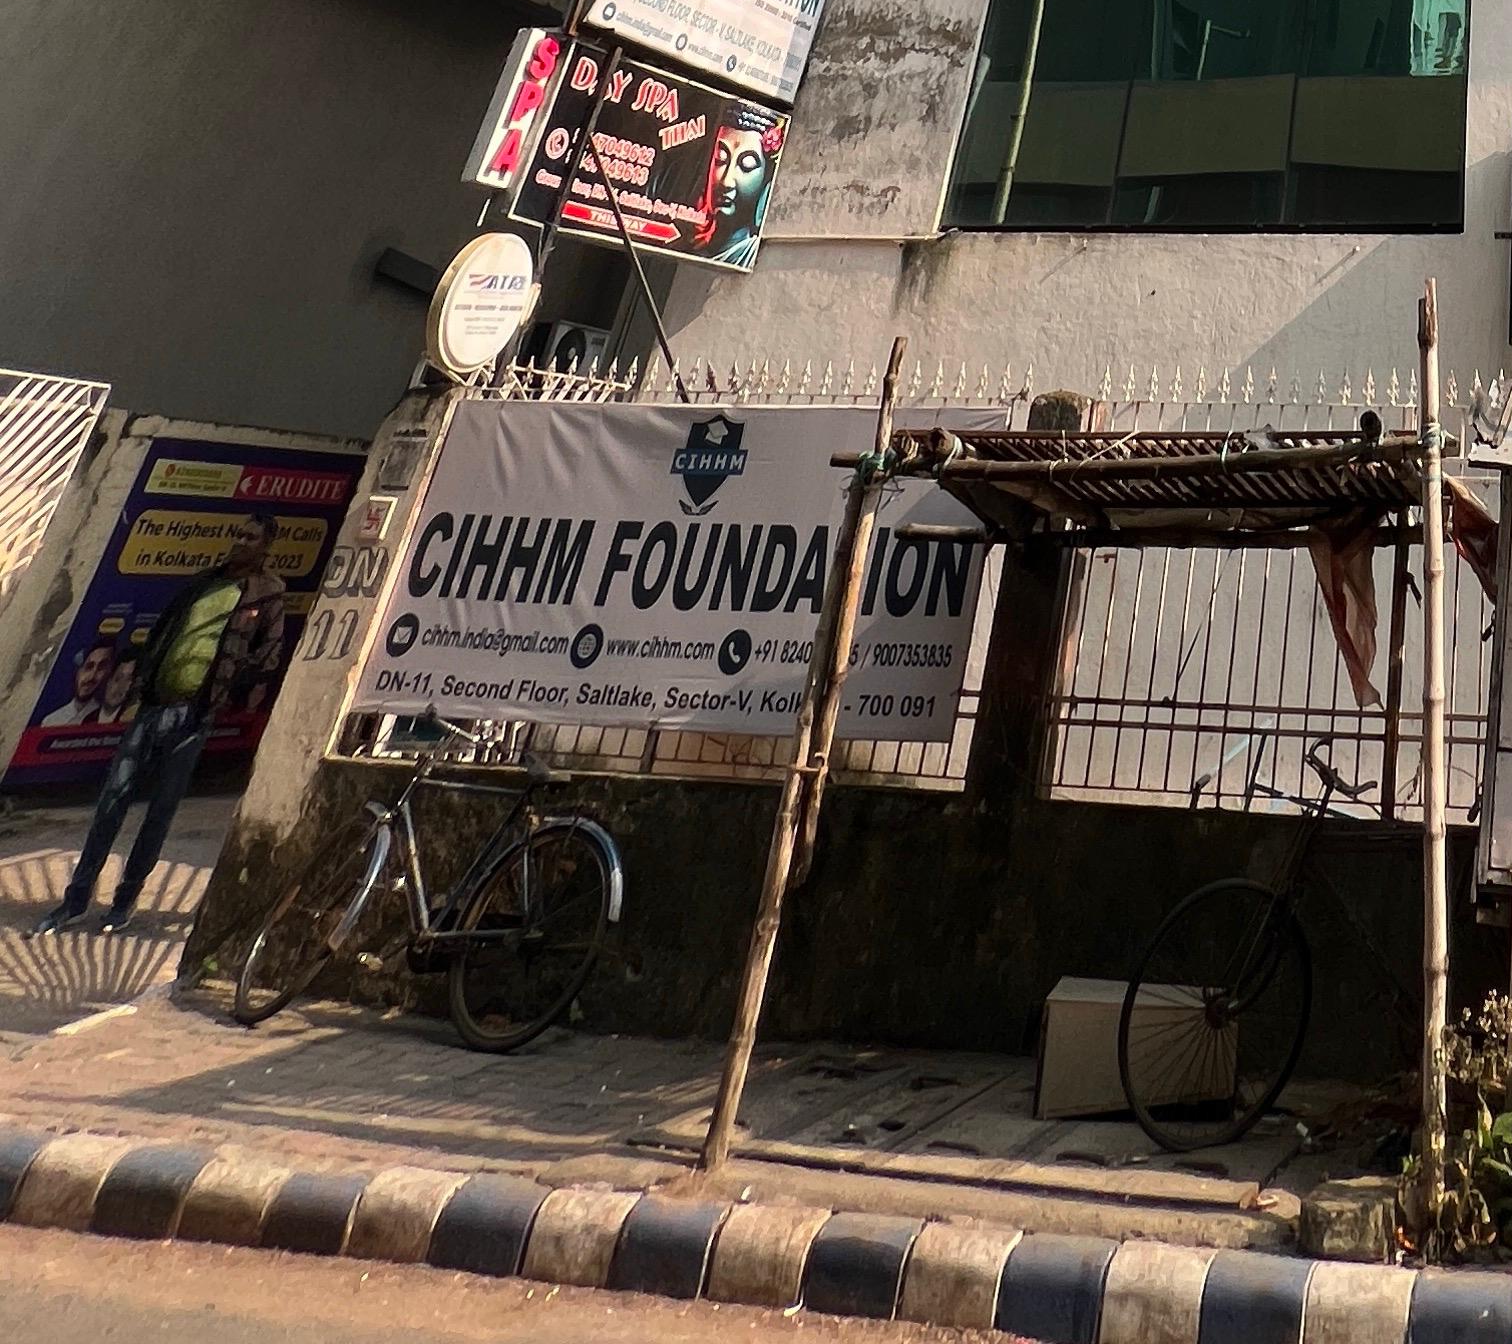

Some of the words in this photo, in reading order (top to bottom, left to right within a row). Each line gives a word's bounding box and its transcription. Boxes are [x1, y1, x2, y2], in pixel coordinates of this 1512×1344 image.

[490, 37, 560, 174] SPA
[570, 55, 633, 104] DY
[631, 77, 680, 124] SPA
[674, 452, 745, 472] CIHHM
[255, 474, 348, 500] ERUDITE
[136, 518, 164, 537] The
[166, 521, 223, 542] Highest
[135, 549, 151, 567] in
[155, 550, 212, 569] Kolkata
[408, 511, 596, 606] CIHHM
[593, 519, 974, 618] FOUNDAION
[302, 609, 359, 660] 11
[605, 635, 715, 661] www.cihhm.com
[754, 639, 779, 663] +91
[375, 669, 435, 698] DN-11,
[440, 674, 514, 701] Second
[517, 679, 569, 706] Floor,
[575, 681, 657, 712] Saltlake,
[663, 686, 753, 716] Sector-V,
[858, 694, 897, 718] 700
[900, 695, 937, 718] 091
